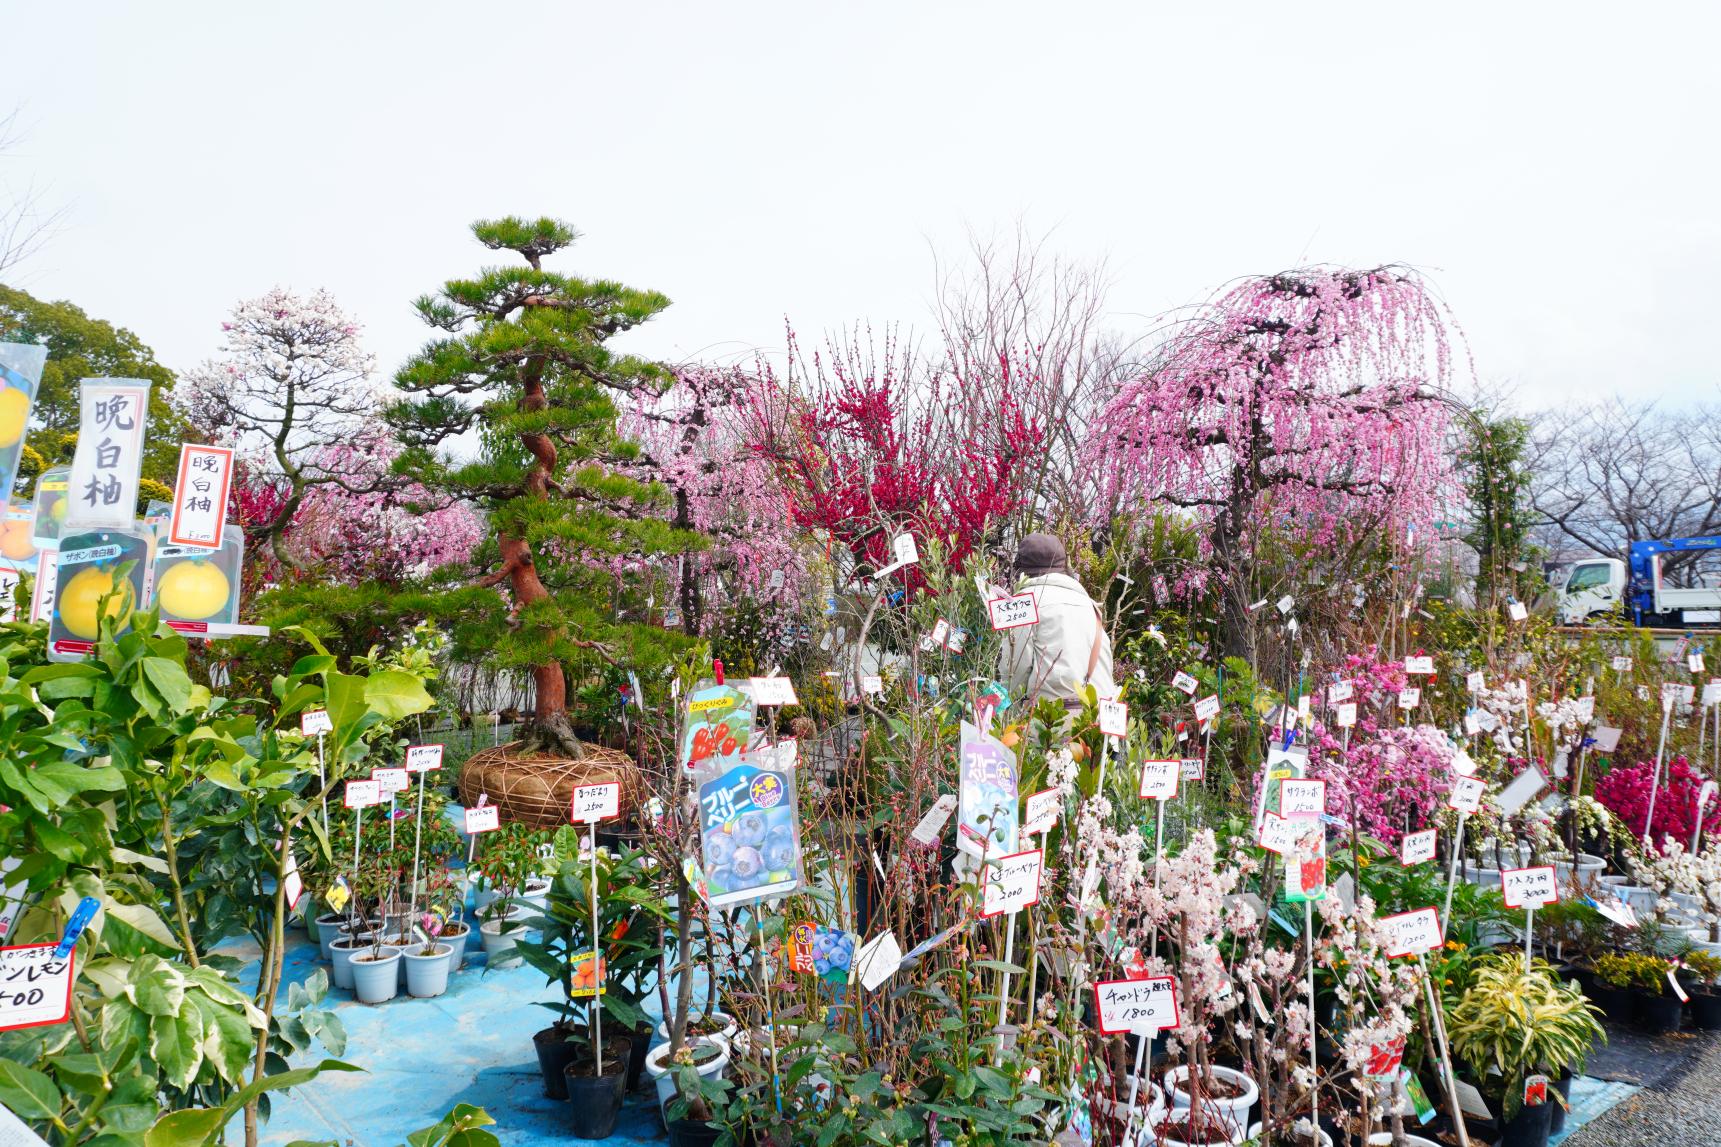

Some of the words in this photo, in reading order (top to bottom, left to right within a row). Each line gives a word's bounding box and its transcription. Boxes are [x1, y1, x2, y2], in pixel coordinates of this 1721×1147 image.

[82, 394, 134, 508] 晩白柚
[184, 455, 219, 514] 晩白柚
[996, 600, 1032, 613] 大実ザクロ
[1006, 611, 1028, 623] 2500
[701, 781, 749, 813] ブルー
[1286, 786, 1322, 798] サクランボ
[584, 802, 604, 812] 2500
[707, 799, 751, 826] ベリー
[1294, 802, 1314, 812] 1500
[999, 887, 1023, 900] 2000
[1105, 988, 1151, 1005] チャンドラ
